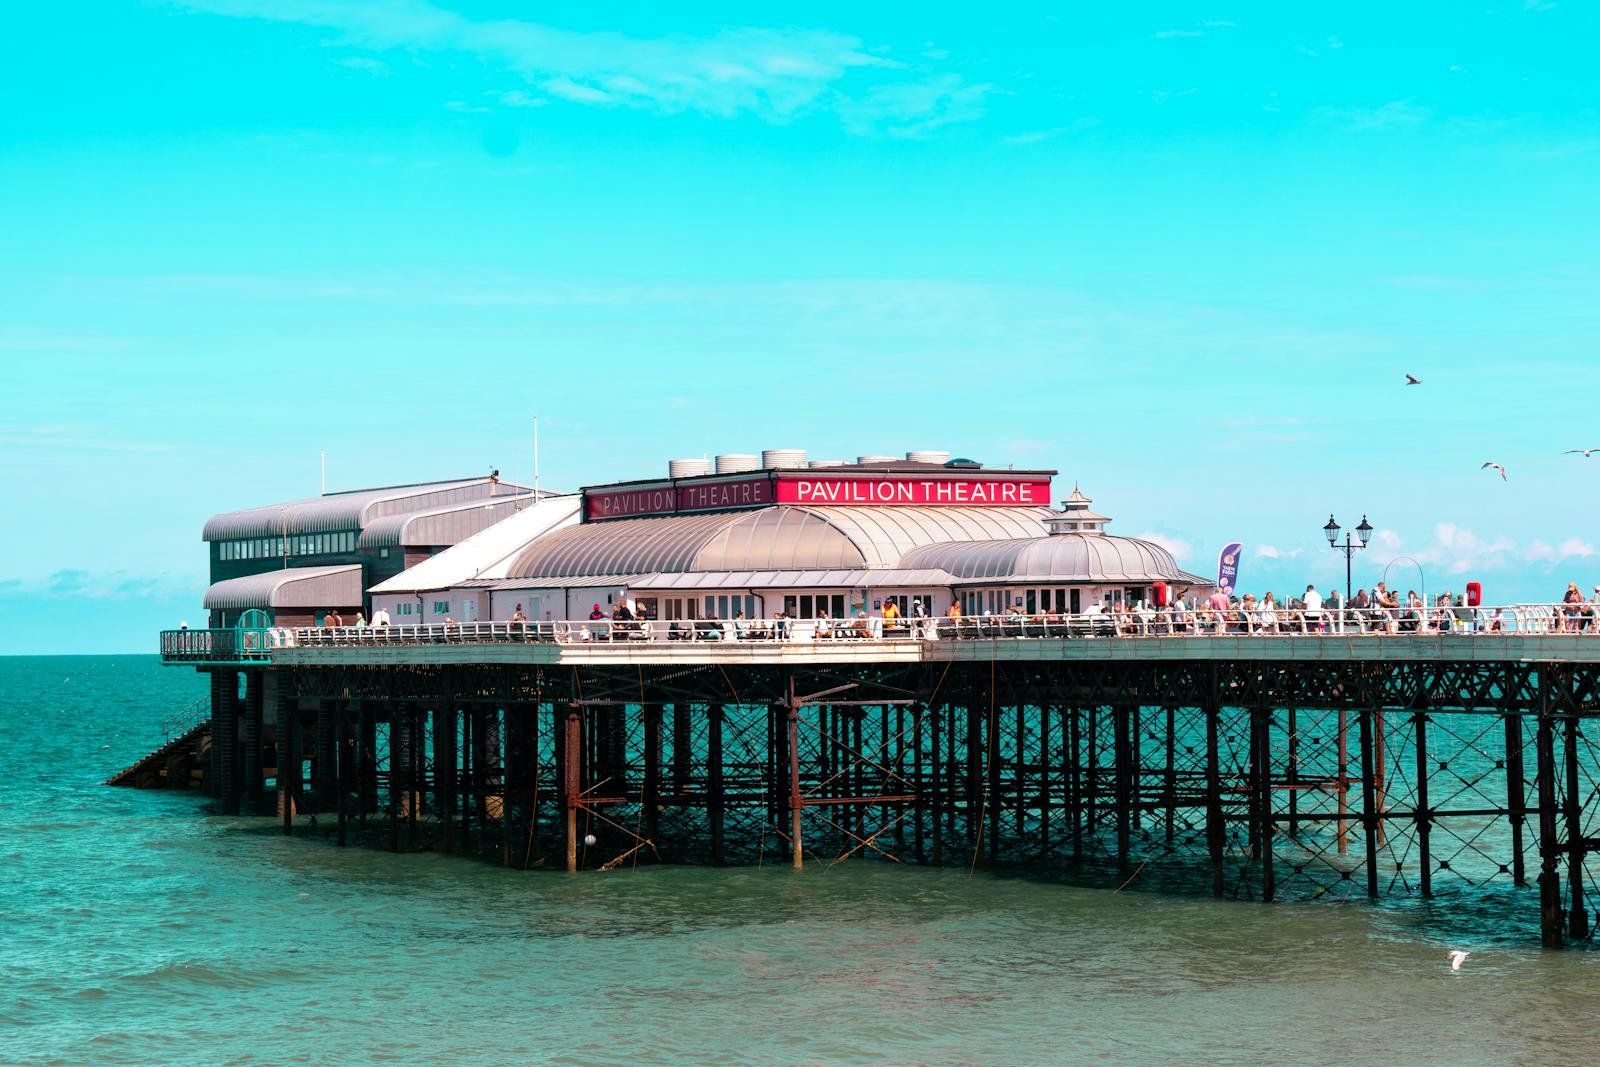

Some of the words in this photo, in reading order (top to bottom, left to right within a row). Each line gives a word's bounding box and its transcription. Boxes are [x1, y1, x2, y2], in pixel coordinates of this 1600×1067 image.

[604, 491, 675, 513] PAVILION
[689, 482, 762, 507] THEATRE
[797, 481, 914, 501] PAVILION
[920, 482, 1033, 502] THEATRE
